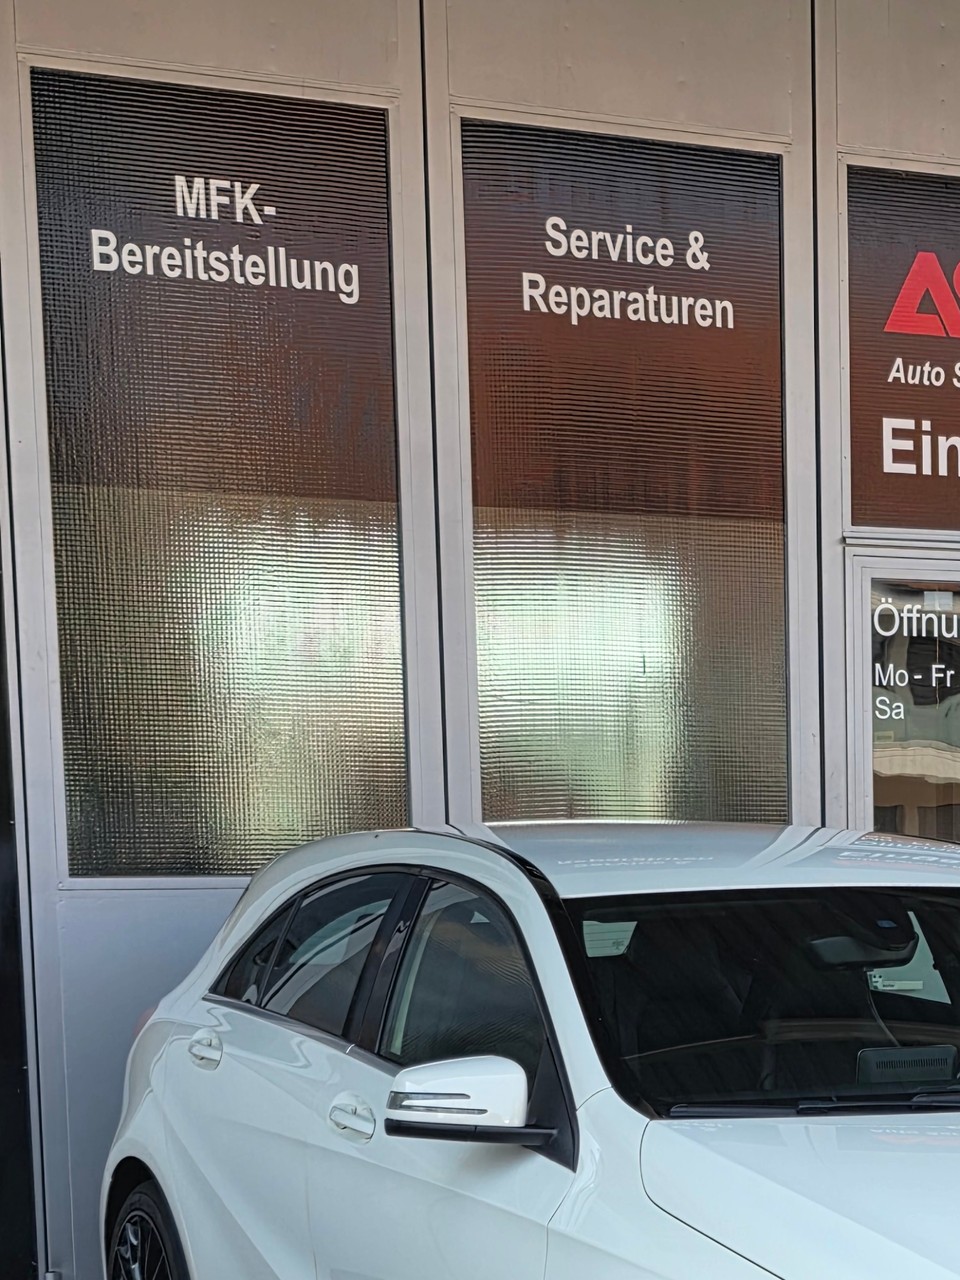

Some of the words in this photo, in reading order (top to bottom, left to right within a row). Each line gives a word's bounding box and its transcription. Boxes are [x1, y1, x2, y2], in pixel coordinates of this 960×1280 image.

[174, 175, 276, 225] MFK-
[91, 229, 360, 304] Bereitstellung
[544, 216, 674, 267] Service
[685, 230, 711, 270] &
[522, 272, 735, 329] Reparaturen
[887, 357, 946, 387] Auto
[874, 663, 908, 687] Mo
[931, 664, 955, 687] Fr
[874, 696, 905, 720] Sa
